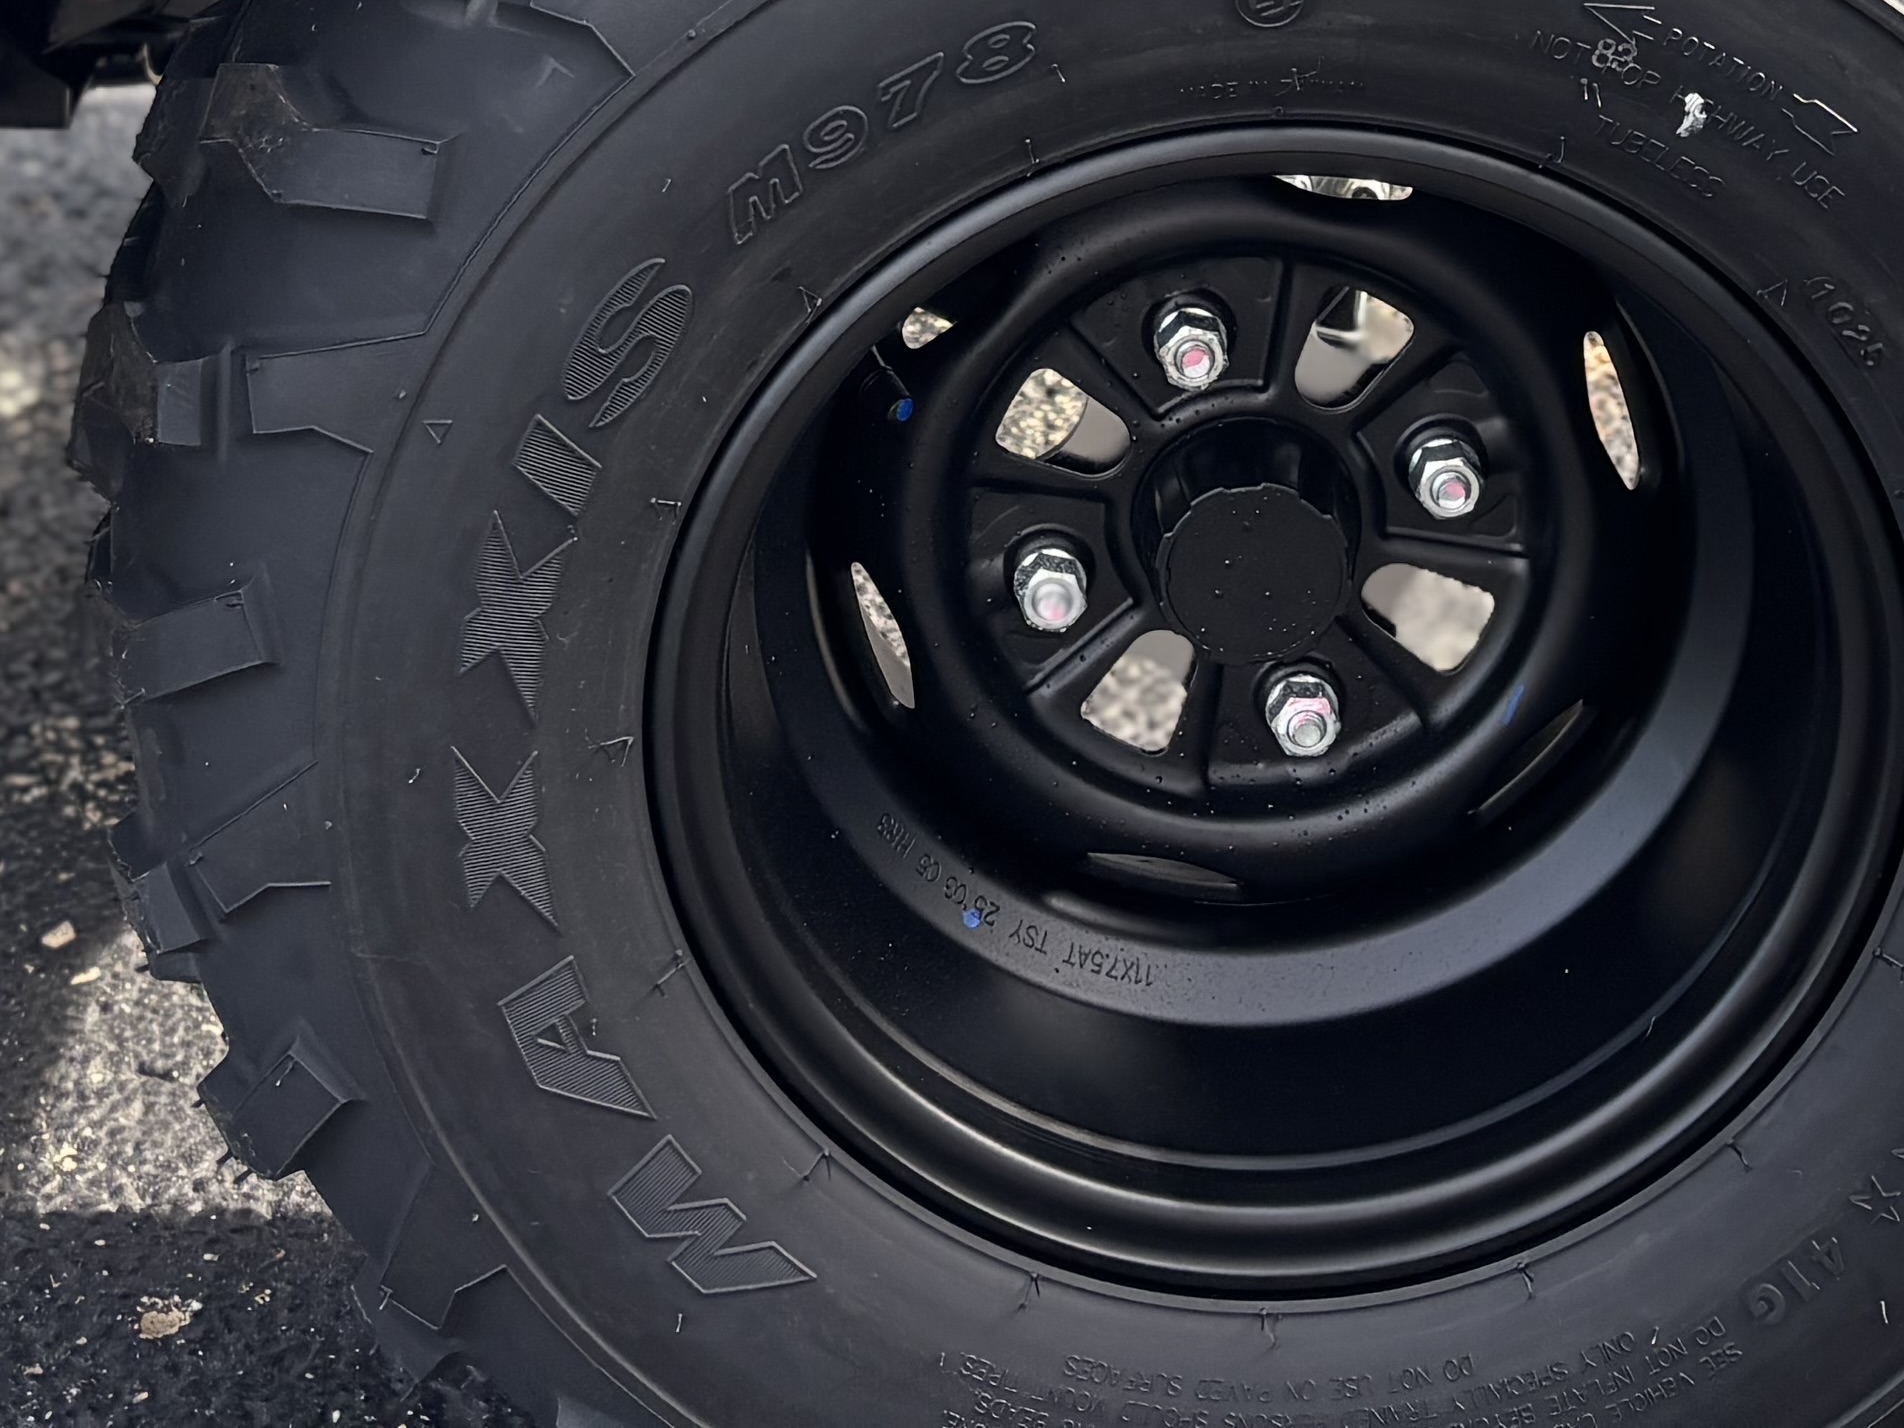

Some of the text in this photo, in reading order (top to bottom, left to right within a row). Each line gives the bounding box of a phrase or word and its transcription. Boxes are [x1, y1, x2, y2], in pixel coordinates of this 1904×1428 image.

[728, 20, 1038, 245] M978
[450, 257, 818, 1294] MAXXIS
[1008, 919, 1048, 955] TSY
[1748, 1236, 1845, 1326] 41G
[1579, 1330, 1636, 1375] ONLY
[1643, 1337, 1689, 1376] NOT
[1694, 1315, 1728, 1347] DO
[1543, 1363, 1637, 1417] INFLATE
[1604, 1341, 1744, 1423] SEE VEHICLE
